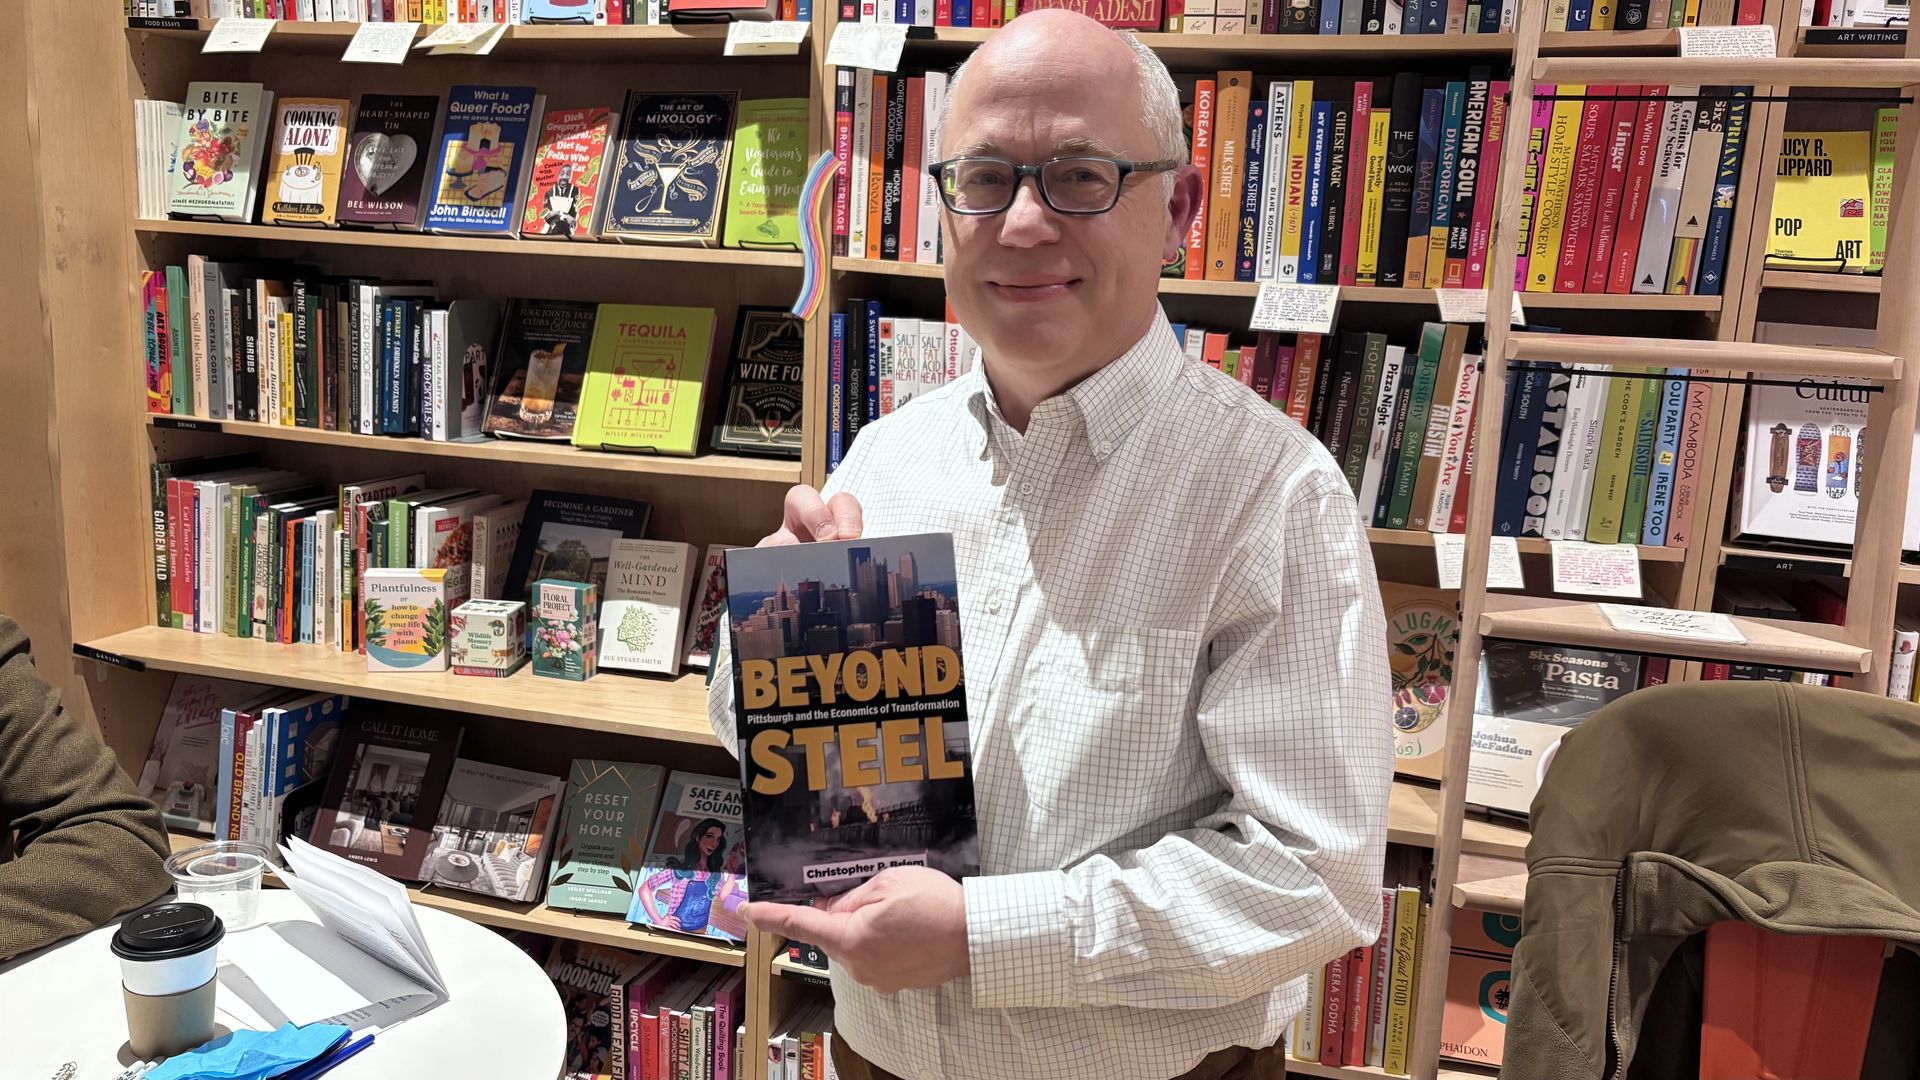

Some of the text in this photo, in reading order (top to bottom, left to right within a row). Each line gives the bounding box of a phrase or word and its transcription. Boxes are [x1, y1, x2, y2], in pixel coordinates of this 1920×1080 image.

[1858, 33, 1899, 41] WRITING
[204, 92, 238, 103] BITE
[187, 110, 249, 122] BY BITE
[360, 110, 430, 120] HEART-SHAPED
[451, 102, 529, 114] Queer Food?
[1274, 91, 1284, 138] ATHENS
[284, 110, 336, 127] COOKING
[384, 122, 400, 130] TIN
[646, 114, 714, 124] MIXOLOGY
[284, 128, 331, 146] ALONE
[887, 109, 895, 160] COOKBOOK
[1393, 131, 1414, 140] THE
[1456, 81, 1488, 202] AMERICAN SOUL
[557, 142, 589, 152] Diet for
[1331, 111, 1346, 188] CHEESE MAGIC
[1611, 121, 1632, 172] Linger
[1780, 138, 1827, 156] UCY R.
[1311, 112, 1325, 208] MY EVERYDAY LAGOS
[1777, 159, 1832, 176] LIPPARD
[837, 126, 848, 231] BRAIDED HERITAGE
[1388, 165, 1413, 174] WOK
[1436, 128, 1456, 221] DIASPORICAN
[1289, 155, 1303, 206] INDIAN
[1416, 161, 1433, 215] BAHARI
[1535, 115, 1567, 259] HOME STYLE COOKERY
[347, 200, 403, 211] BEE WILSON
[430, 206, 506, 218] John Birdsall
[884, 182, 892, 225] RODBARD
[1287, 209, 1299, 235] (-ish)
[1775, 218, 1802, 236] POP
[1265, 215, 1274, 255] KOCHILAS
[1449, 227, 1459, 250] MALIK
[1458, 228, 1468, 250] ANELA
[1836, 240, 1863, 259] ART
[1409, 272, 1420, 280] DK
[297, 288, 306, 342] WINE FOLLY
[156, 311, 167, 366] ART BOOZEL
[619, 323, 687, 339] TEQUILA
[867, 319, 875, 350] SWEET
[896, 334, 916, 346] SALT
[362, 312, 372, 379] ZERO PROOF
[899, 347, 913, 357] FAT
[922, 337, 942, 349] SALT
[246, 335, 255, 373] SHRUBS
[897, 358, 915, 369] ACID
[922, 362, 940, 372] ACID
[896, 370, 916, 382] HEAT
[921, 372, 942, 384] HEAT
[392, 381, 400, 414] BOTANIST
[423, 363, 433, 423] MOCKTAILS
[1377, 363, 1399, 426] Pizza Night
[1410, 359, 1437, 420] Boustany
[1423, 404, 1450, 457] FALASTIN
[1681, 390, 1703, 480] MY CAMBODIA
[544, 500, 583, 511] BECOMING
[593, 505, 634, 517] GARDENER
[1650, 472, 1669, 536] IRENE YOO
[154, 510, 166, 581] GARDEN WILD
[614, 560, 678, 574] Well-Gardened
[1776, 563, 1793, 571] ART
[371, 584, 437, 593] Plantfulness
[621, 574, 667, 587] MIND
[543, 592, 569, 604] FLORAL
[543, 601, 571, 612] PROJECT
[467, 638, 492, 646] Memory
[96, 653, 120, 663] GARDEN
[1528, 650, 1608, 669] Six Seasons
[742, 644, 961, 710] BEYOND
[1532, 663, 1619, 690] of Pasta
[747, 699, 960, 725] Pittsburgh and the Economics of Transformation
[221, 720, 232, 745] Joie
[362, 720, 439, 742] CALL IT HOME
[1473, 731, 1517, 745] Joshua
[750, 715, 965, 795] STEEL
[1471, 739, 1533, 757] McFadden
[585, 793, 630, 806] RESET
[694, 800, 742, 816] SOUND
[584, 809, 625, 822] YOUR
[579, 824, 623, 838] HOME
[577, 851, 602, 859] emotions
[807, 862, 875, 880] Christopher
[877, 861, 888, 871] P.
[1327, 958, 1342, 1034] MEERA SODHA
[630, 1008, 639, 1053] UPCYCLE
[661, 1016, 669, 1036] SEW
[717, 1021, 725, 1052] Quilting
[1440, 1042, 1488, 1057] PHAIDON
